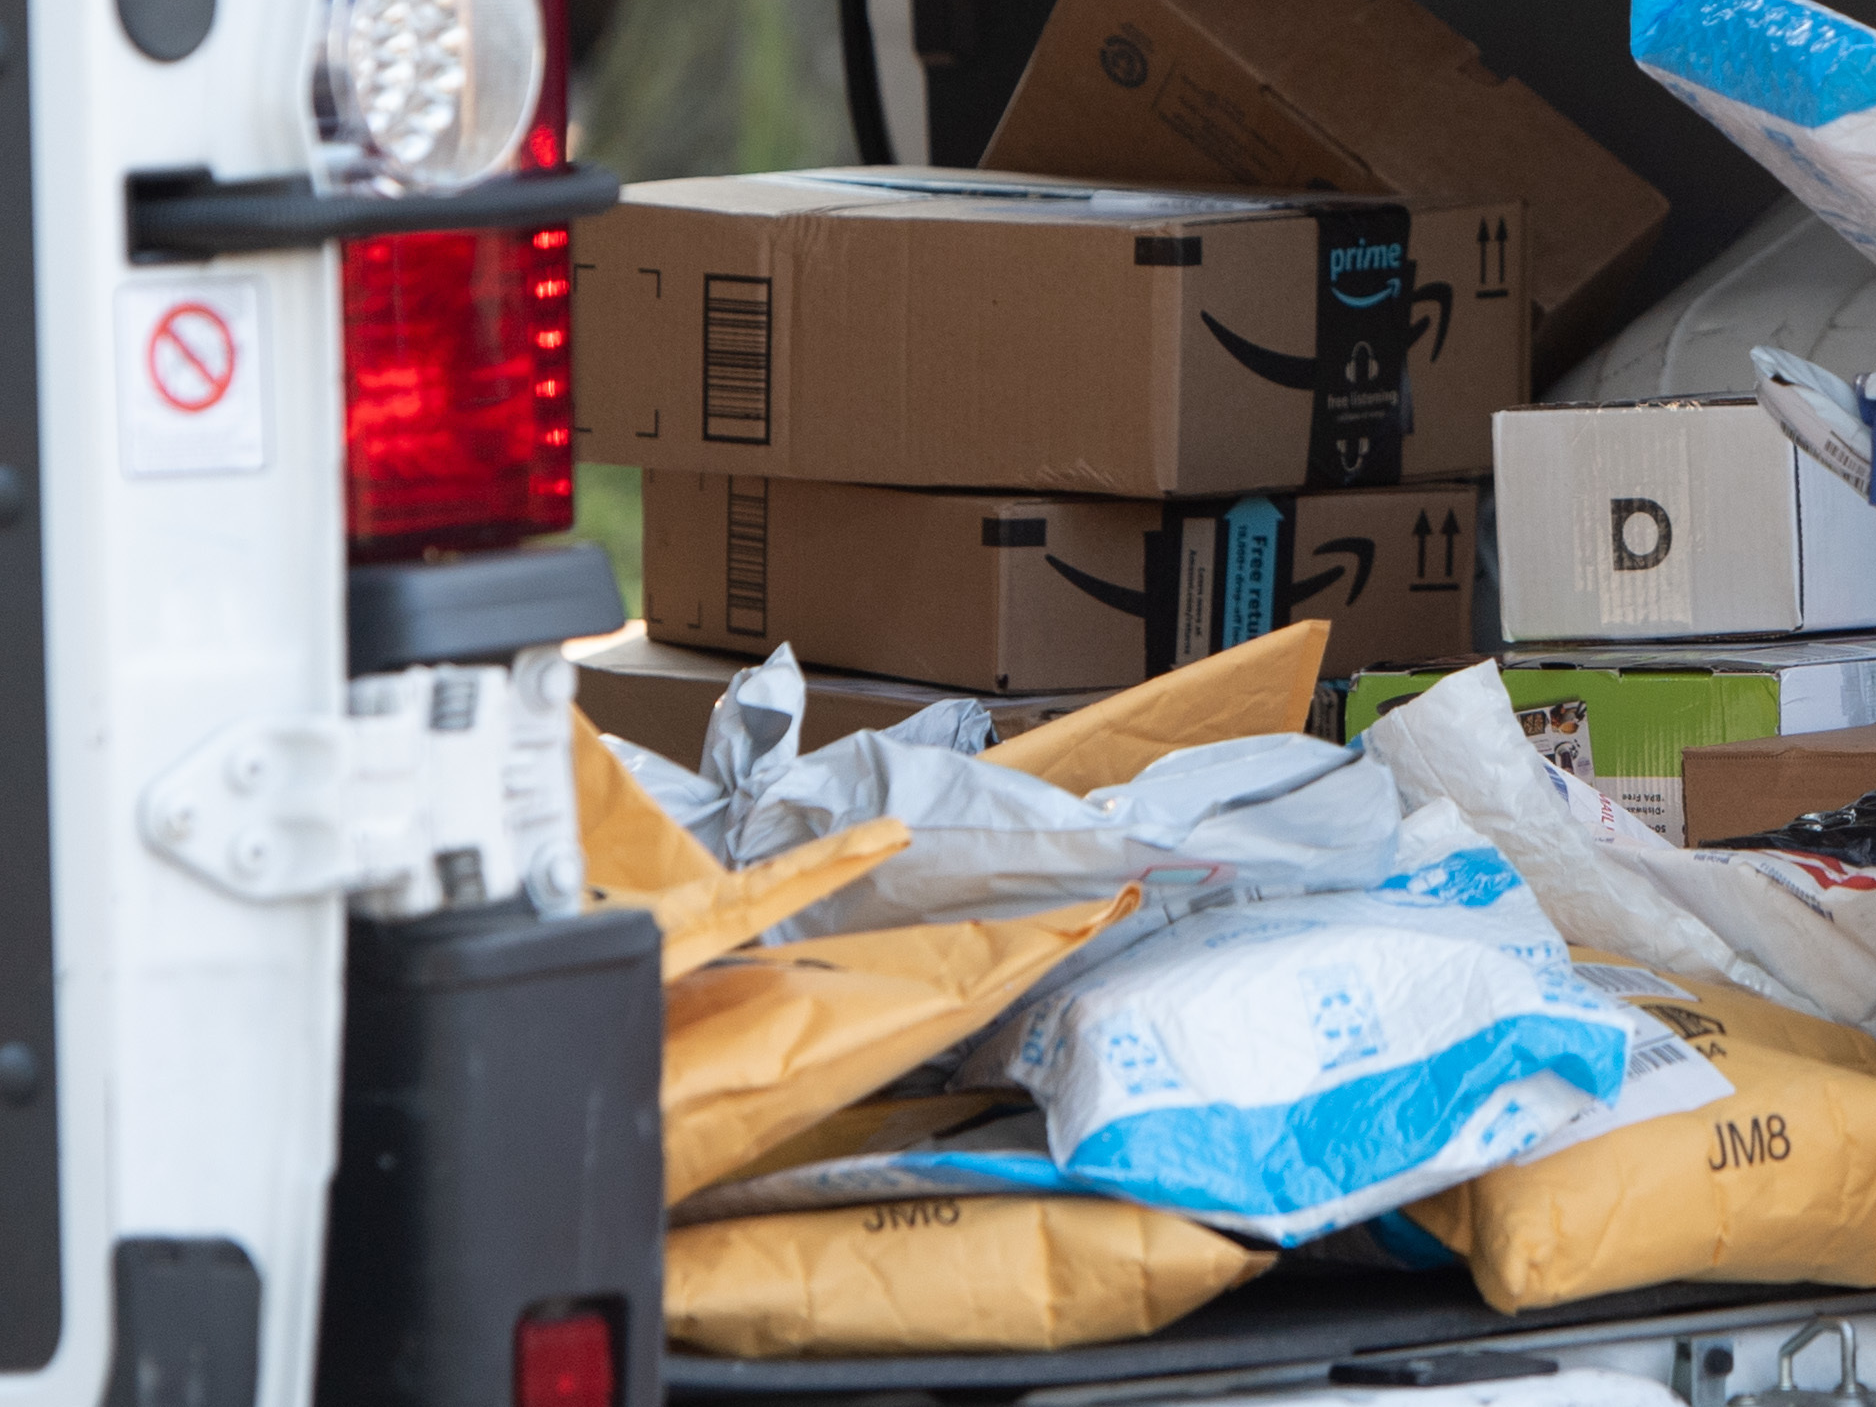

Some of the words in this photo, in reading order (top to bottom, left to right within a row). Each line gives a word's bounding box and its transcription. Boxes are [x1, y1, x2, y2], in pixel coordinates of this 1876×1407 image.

[1329, 237, 1403, 283] prime
[1250, 534, 1268, 584] Free
[1610, 497, 1673, 571] D
[1246, 588, 1262, 640] retu
[1622, 793, 1641, 802] Free
[1643, 793, 1661, 802] BPA
[1708, 1113, 1792, 1172] JM8
